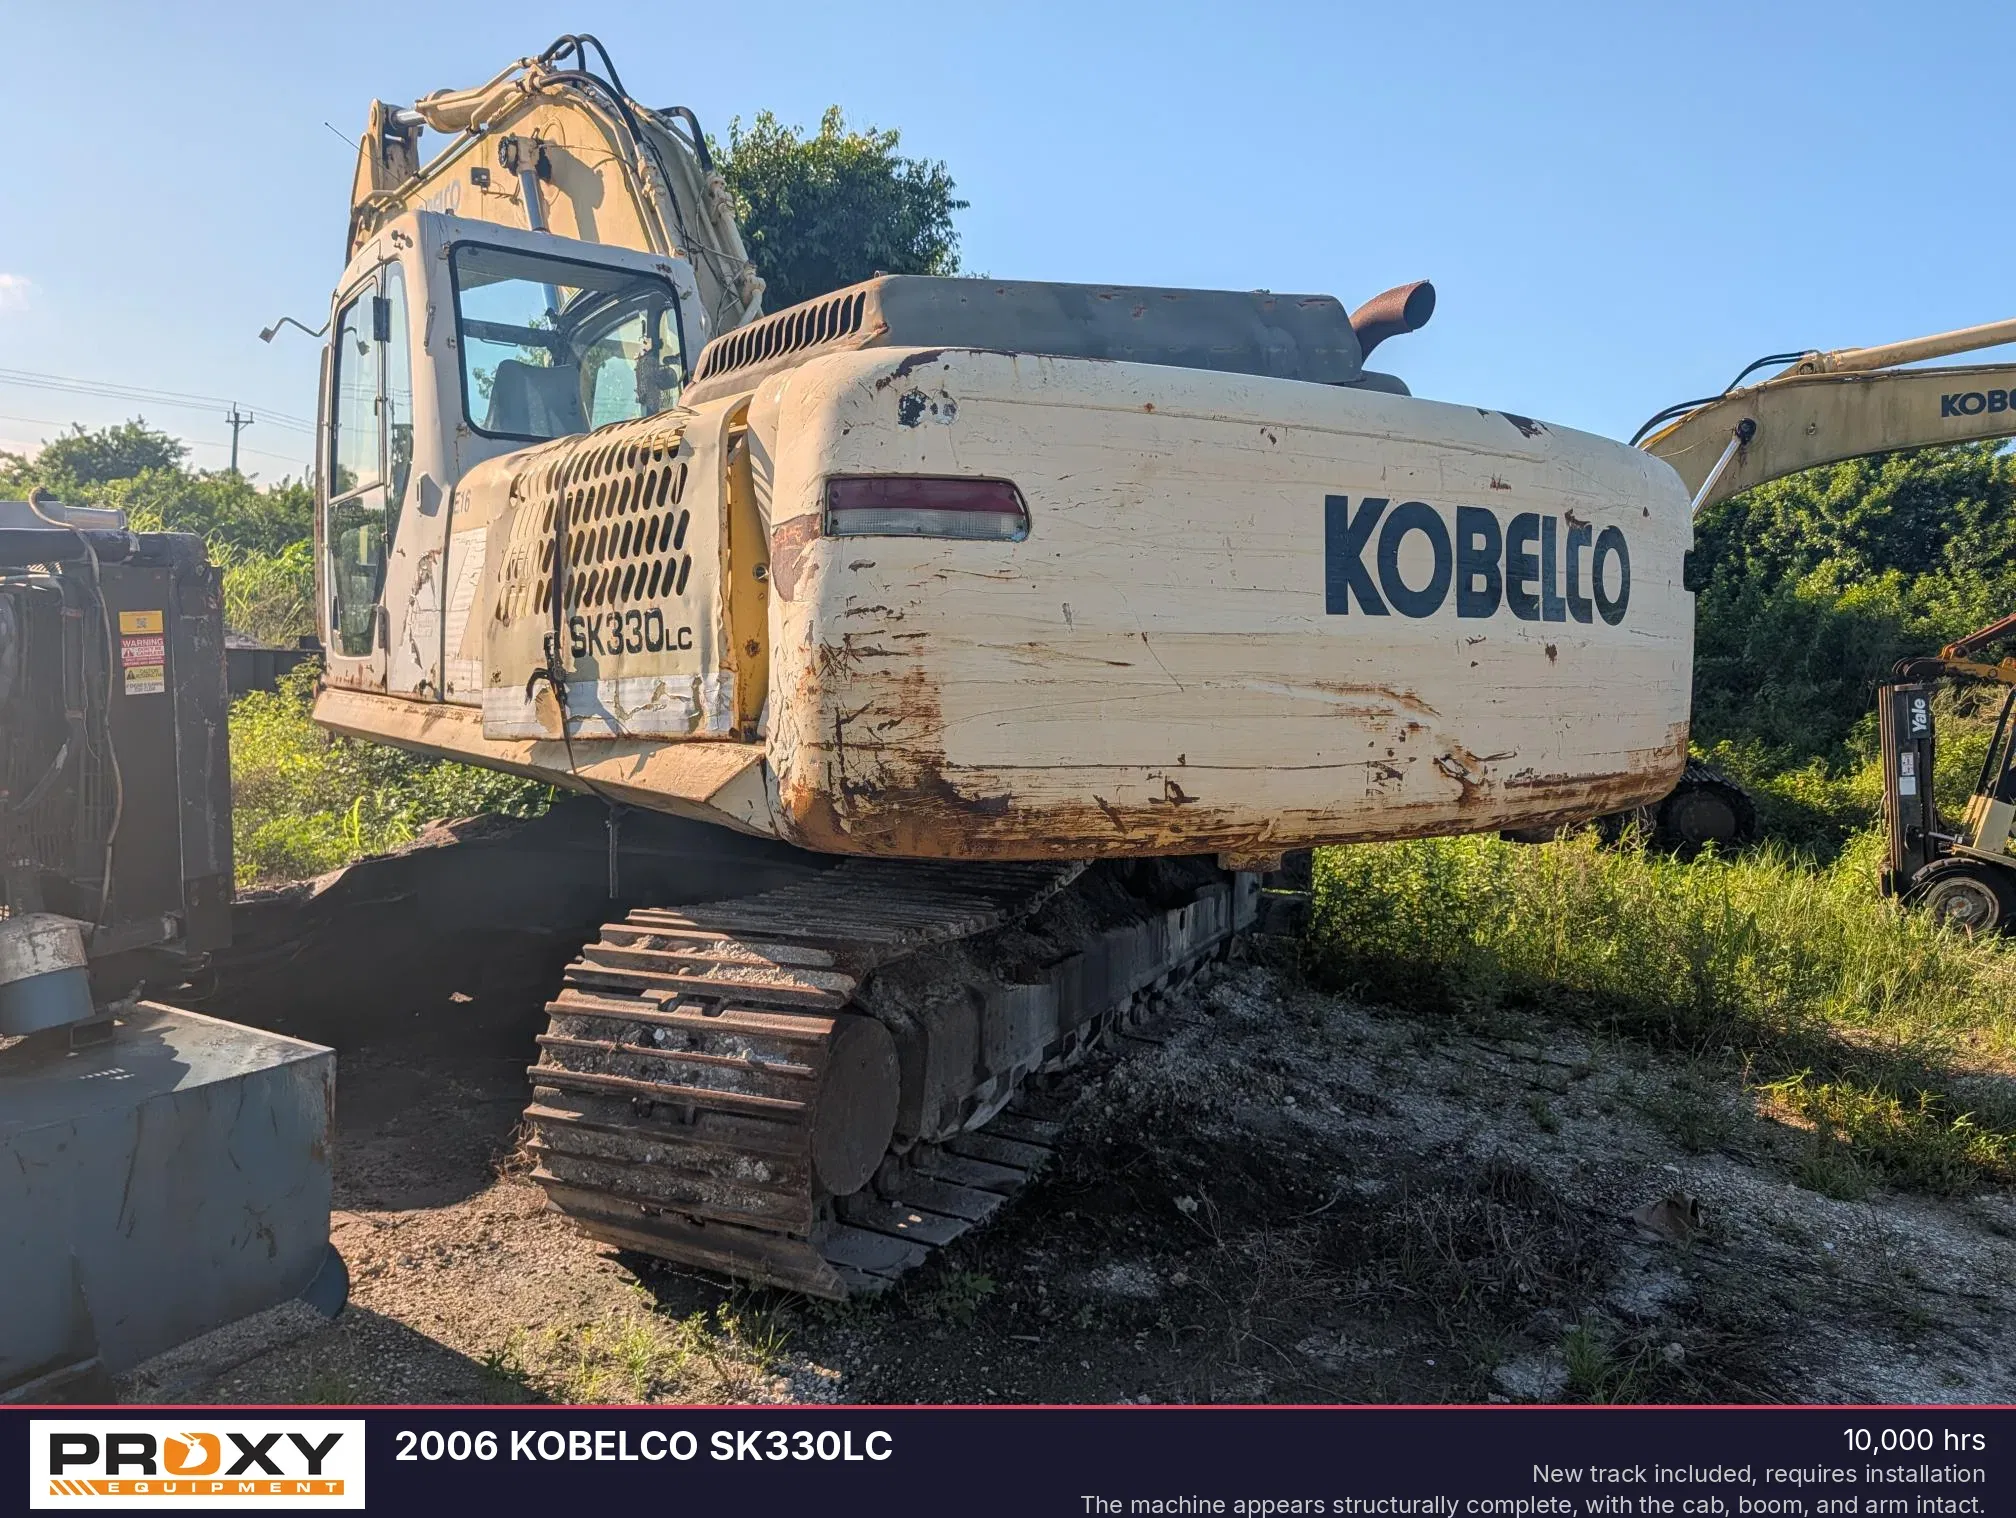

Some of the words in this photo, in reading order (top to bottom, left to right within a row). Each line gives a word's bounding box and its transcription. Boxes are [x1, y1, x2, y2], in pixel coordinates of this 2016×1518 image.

[1324, 494, 1631, 626] KOBELCO
[122, 638, 164, 648] WARNING
[569, 607, 693, 658] SK330LC
[1911, 698, 1927, 732] Yale
